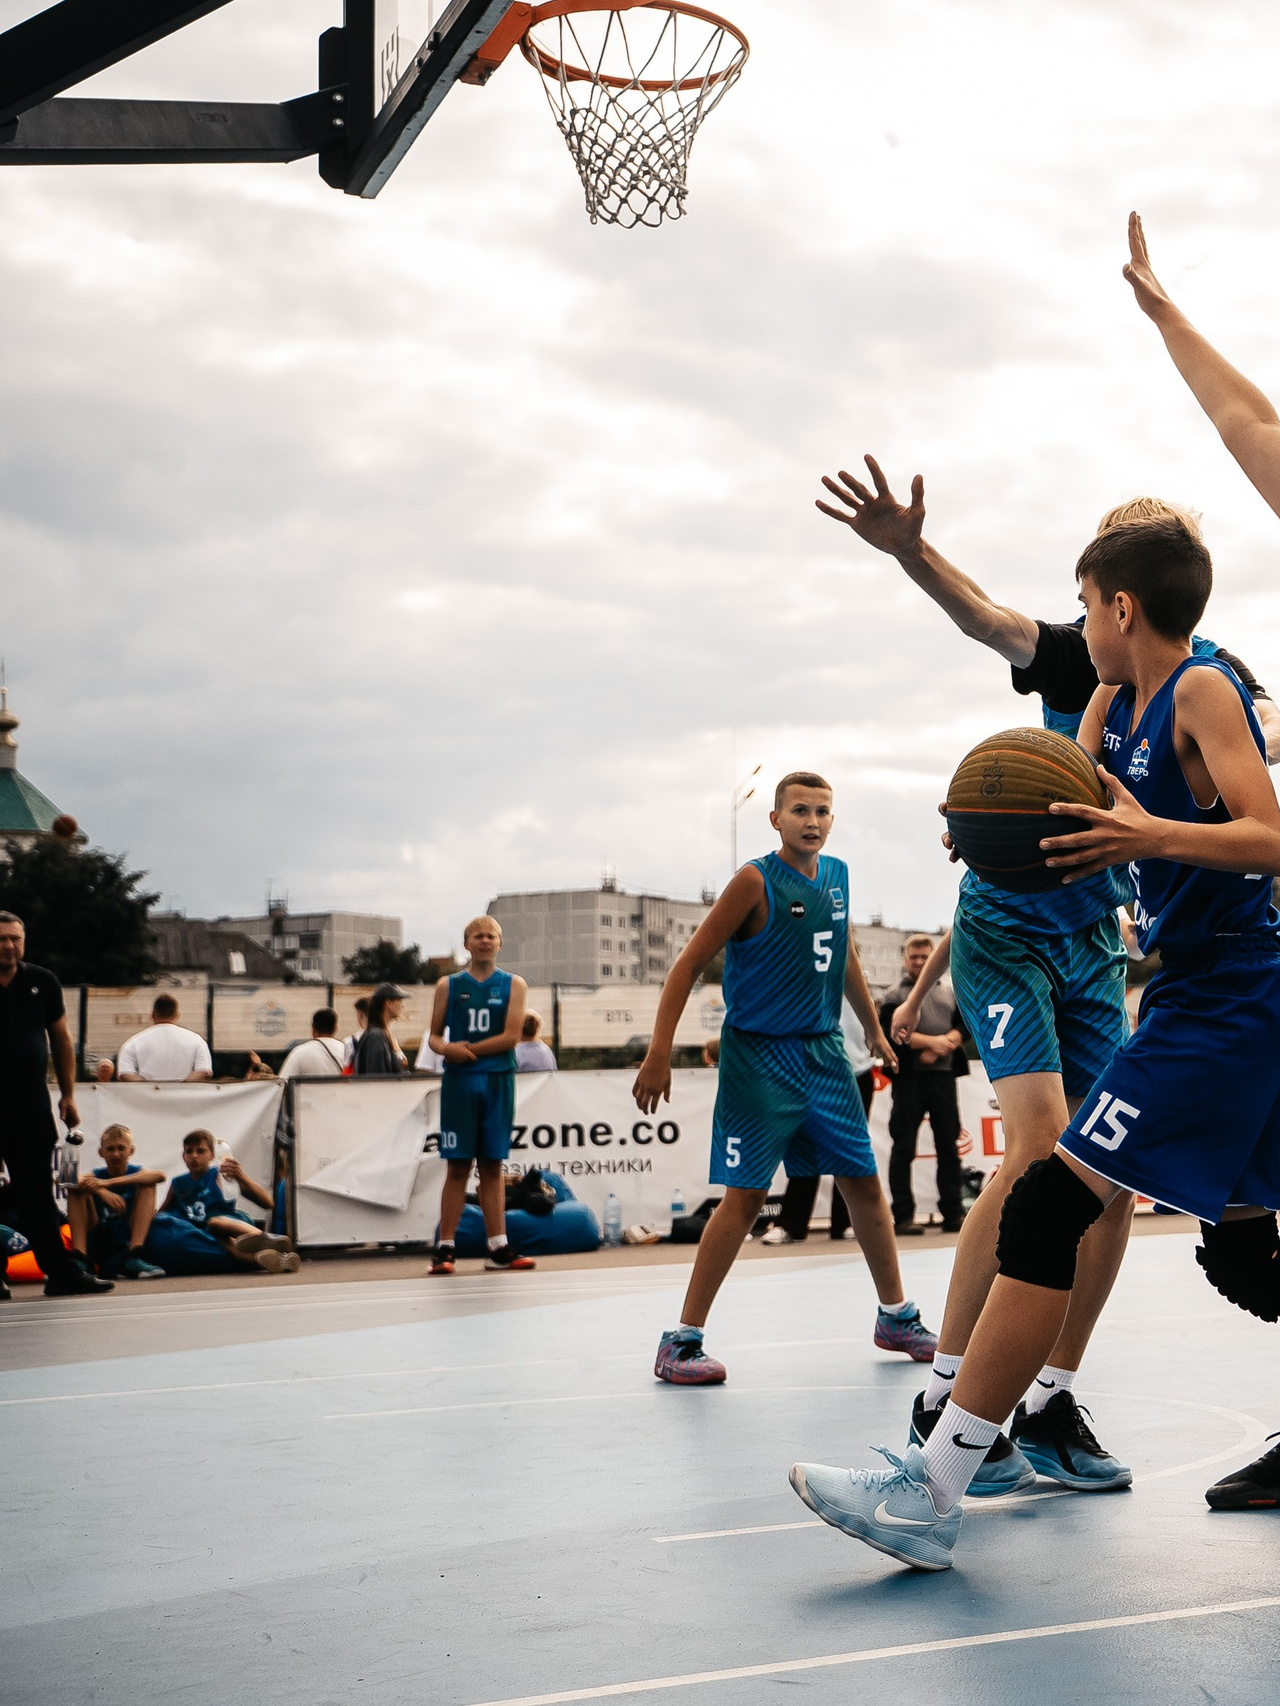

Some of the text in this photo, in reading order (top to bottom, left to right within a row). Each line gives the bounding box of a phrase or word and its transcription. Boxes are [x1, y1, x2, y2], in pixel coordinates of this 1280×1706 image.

[812, 930, 834, 972] 5
[468, 1008, 491, 1033] 10
[988, 1003, 1015, 1050] 7
[423, 1120, 680, 1153] azone.co
[1080, 1090, 1141, 1151] 15
[442, 1131, 458, 1149] 10
[725, 1137, 742, 1168] 5
[557, 1157, 652, 1176] техники
